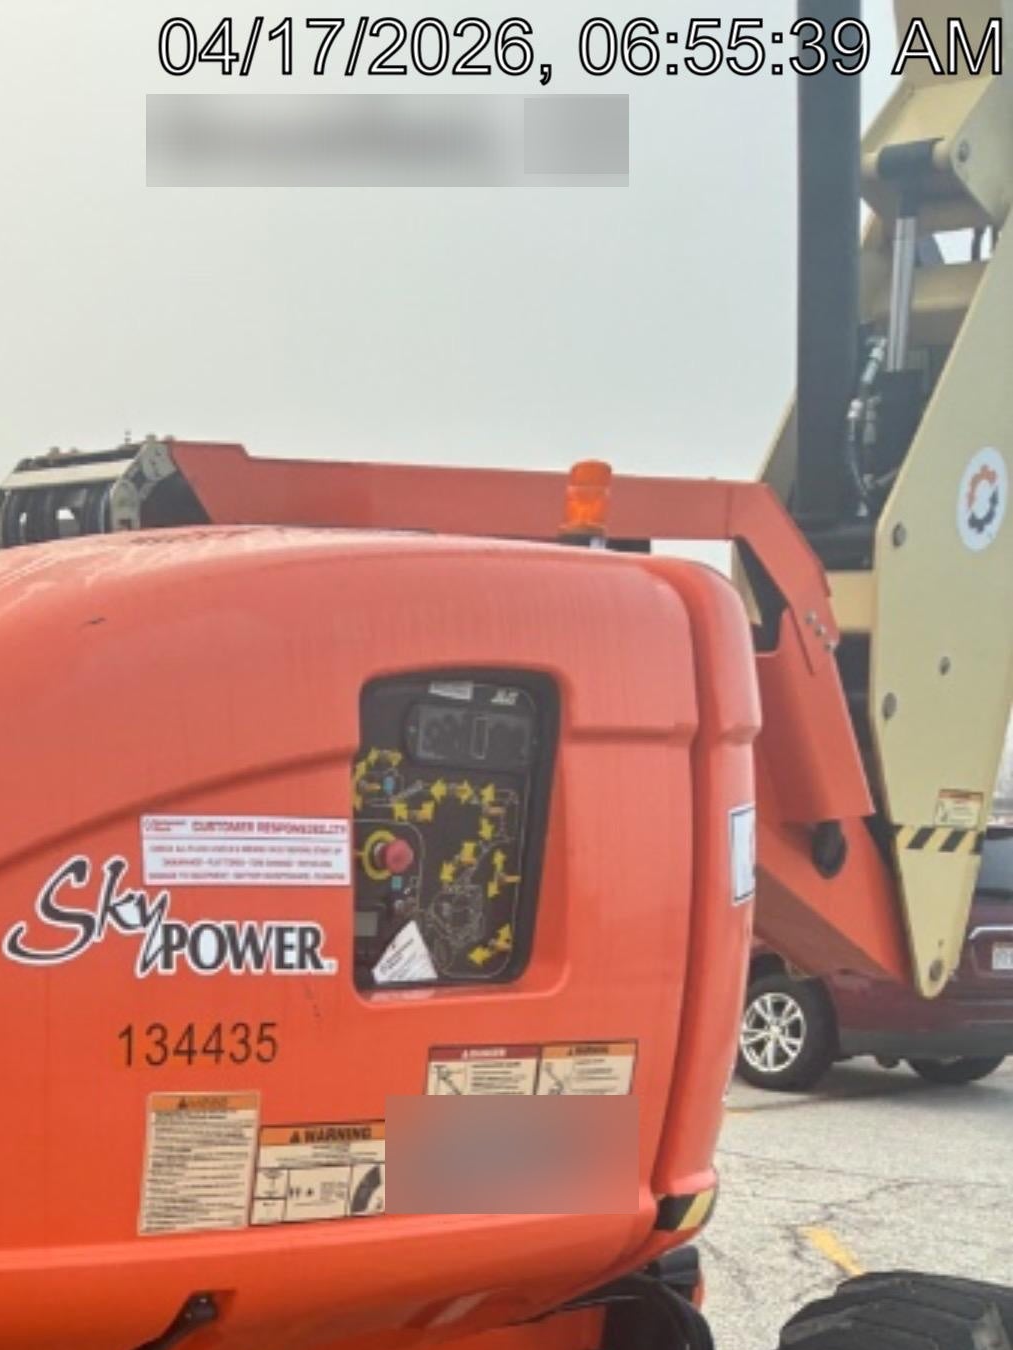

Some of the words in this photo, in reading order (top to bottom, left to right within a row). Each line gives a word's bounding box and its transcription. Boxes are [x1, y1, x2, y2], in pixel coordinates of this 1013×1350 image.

[3, 856, 170, 977] Sky
[159, 921, 326, 973] POWER
[118, 1022, 278, 1066] 134435
